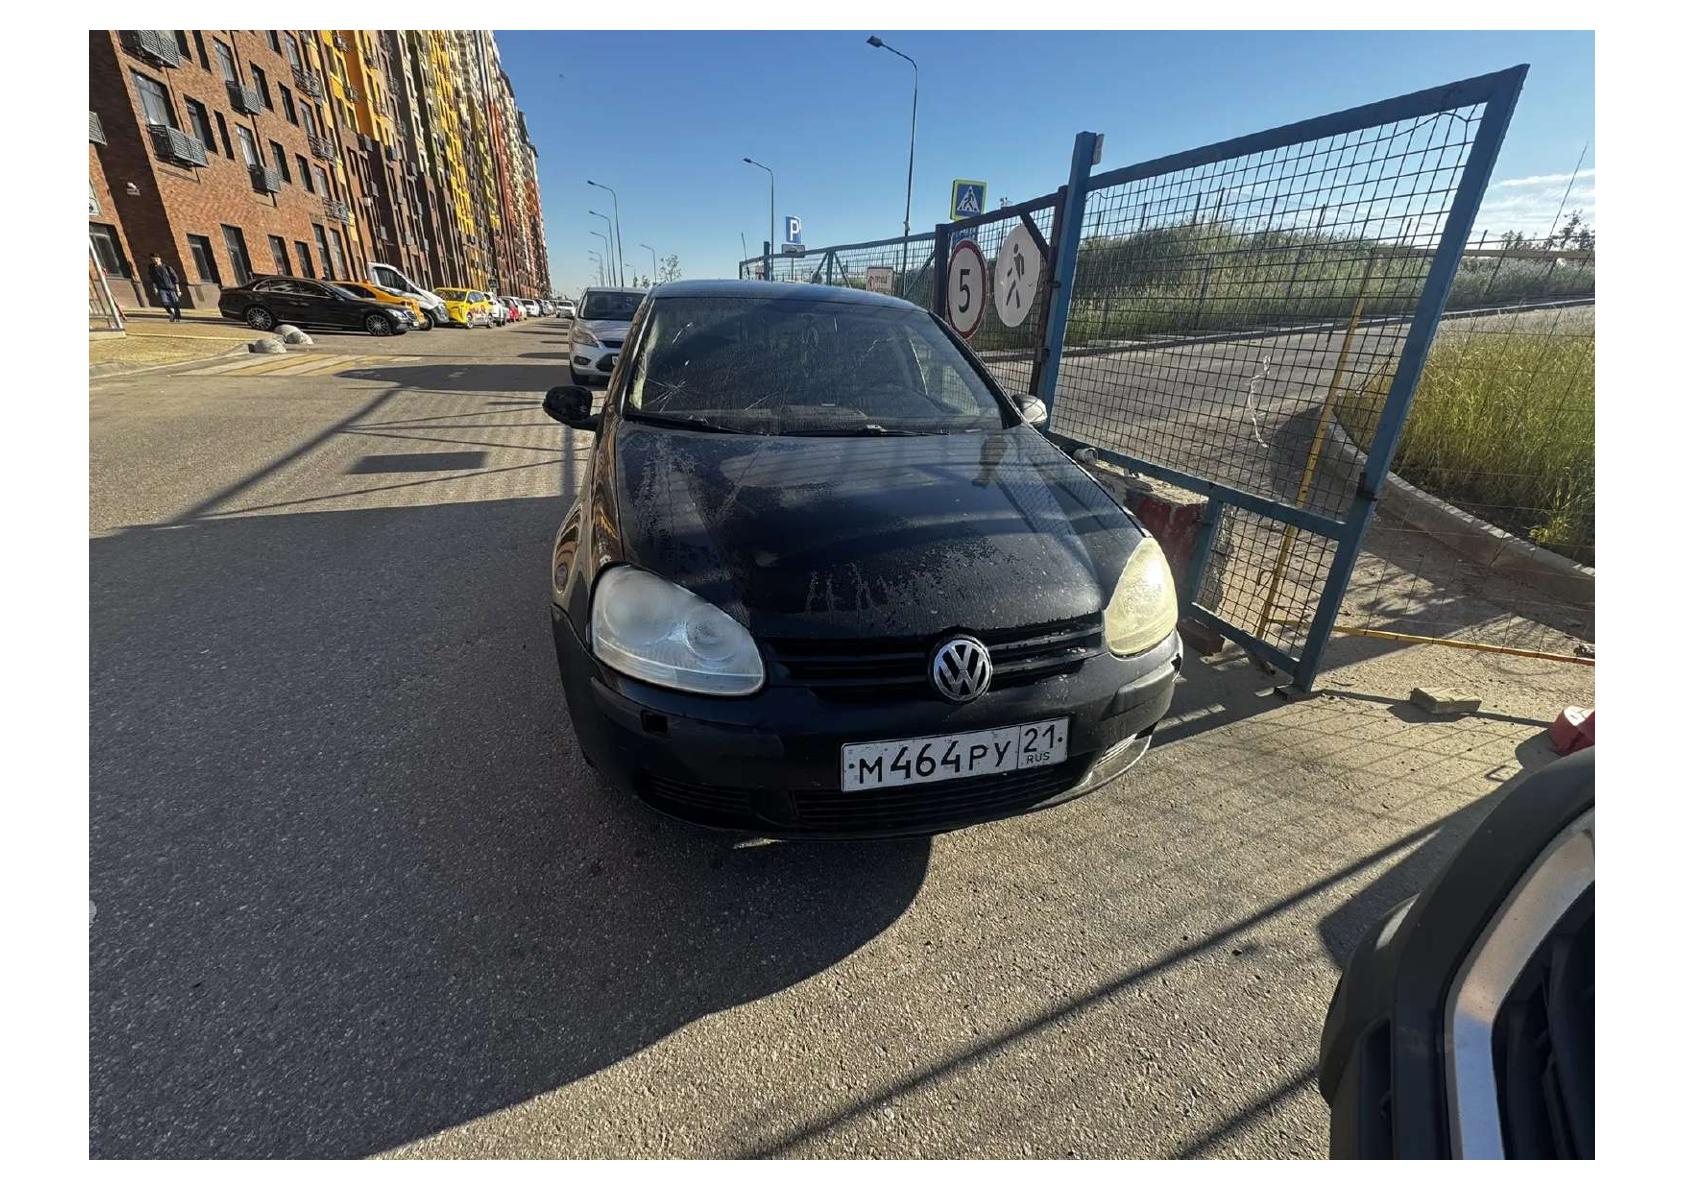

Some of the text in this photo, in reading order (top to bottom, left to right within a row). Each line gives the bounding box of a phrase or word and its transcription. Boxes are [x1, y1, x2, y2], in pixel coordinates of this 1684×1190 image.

[790, 219, 800, 241] P
[958, 268, 970, 313] 5
[1023, 724, 1055, 753] 21
[1026, 752, 1050, 764] RUS
